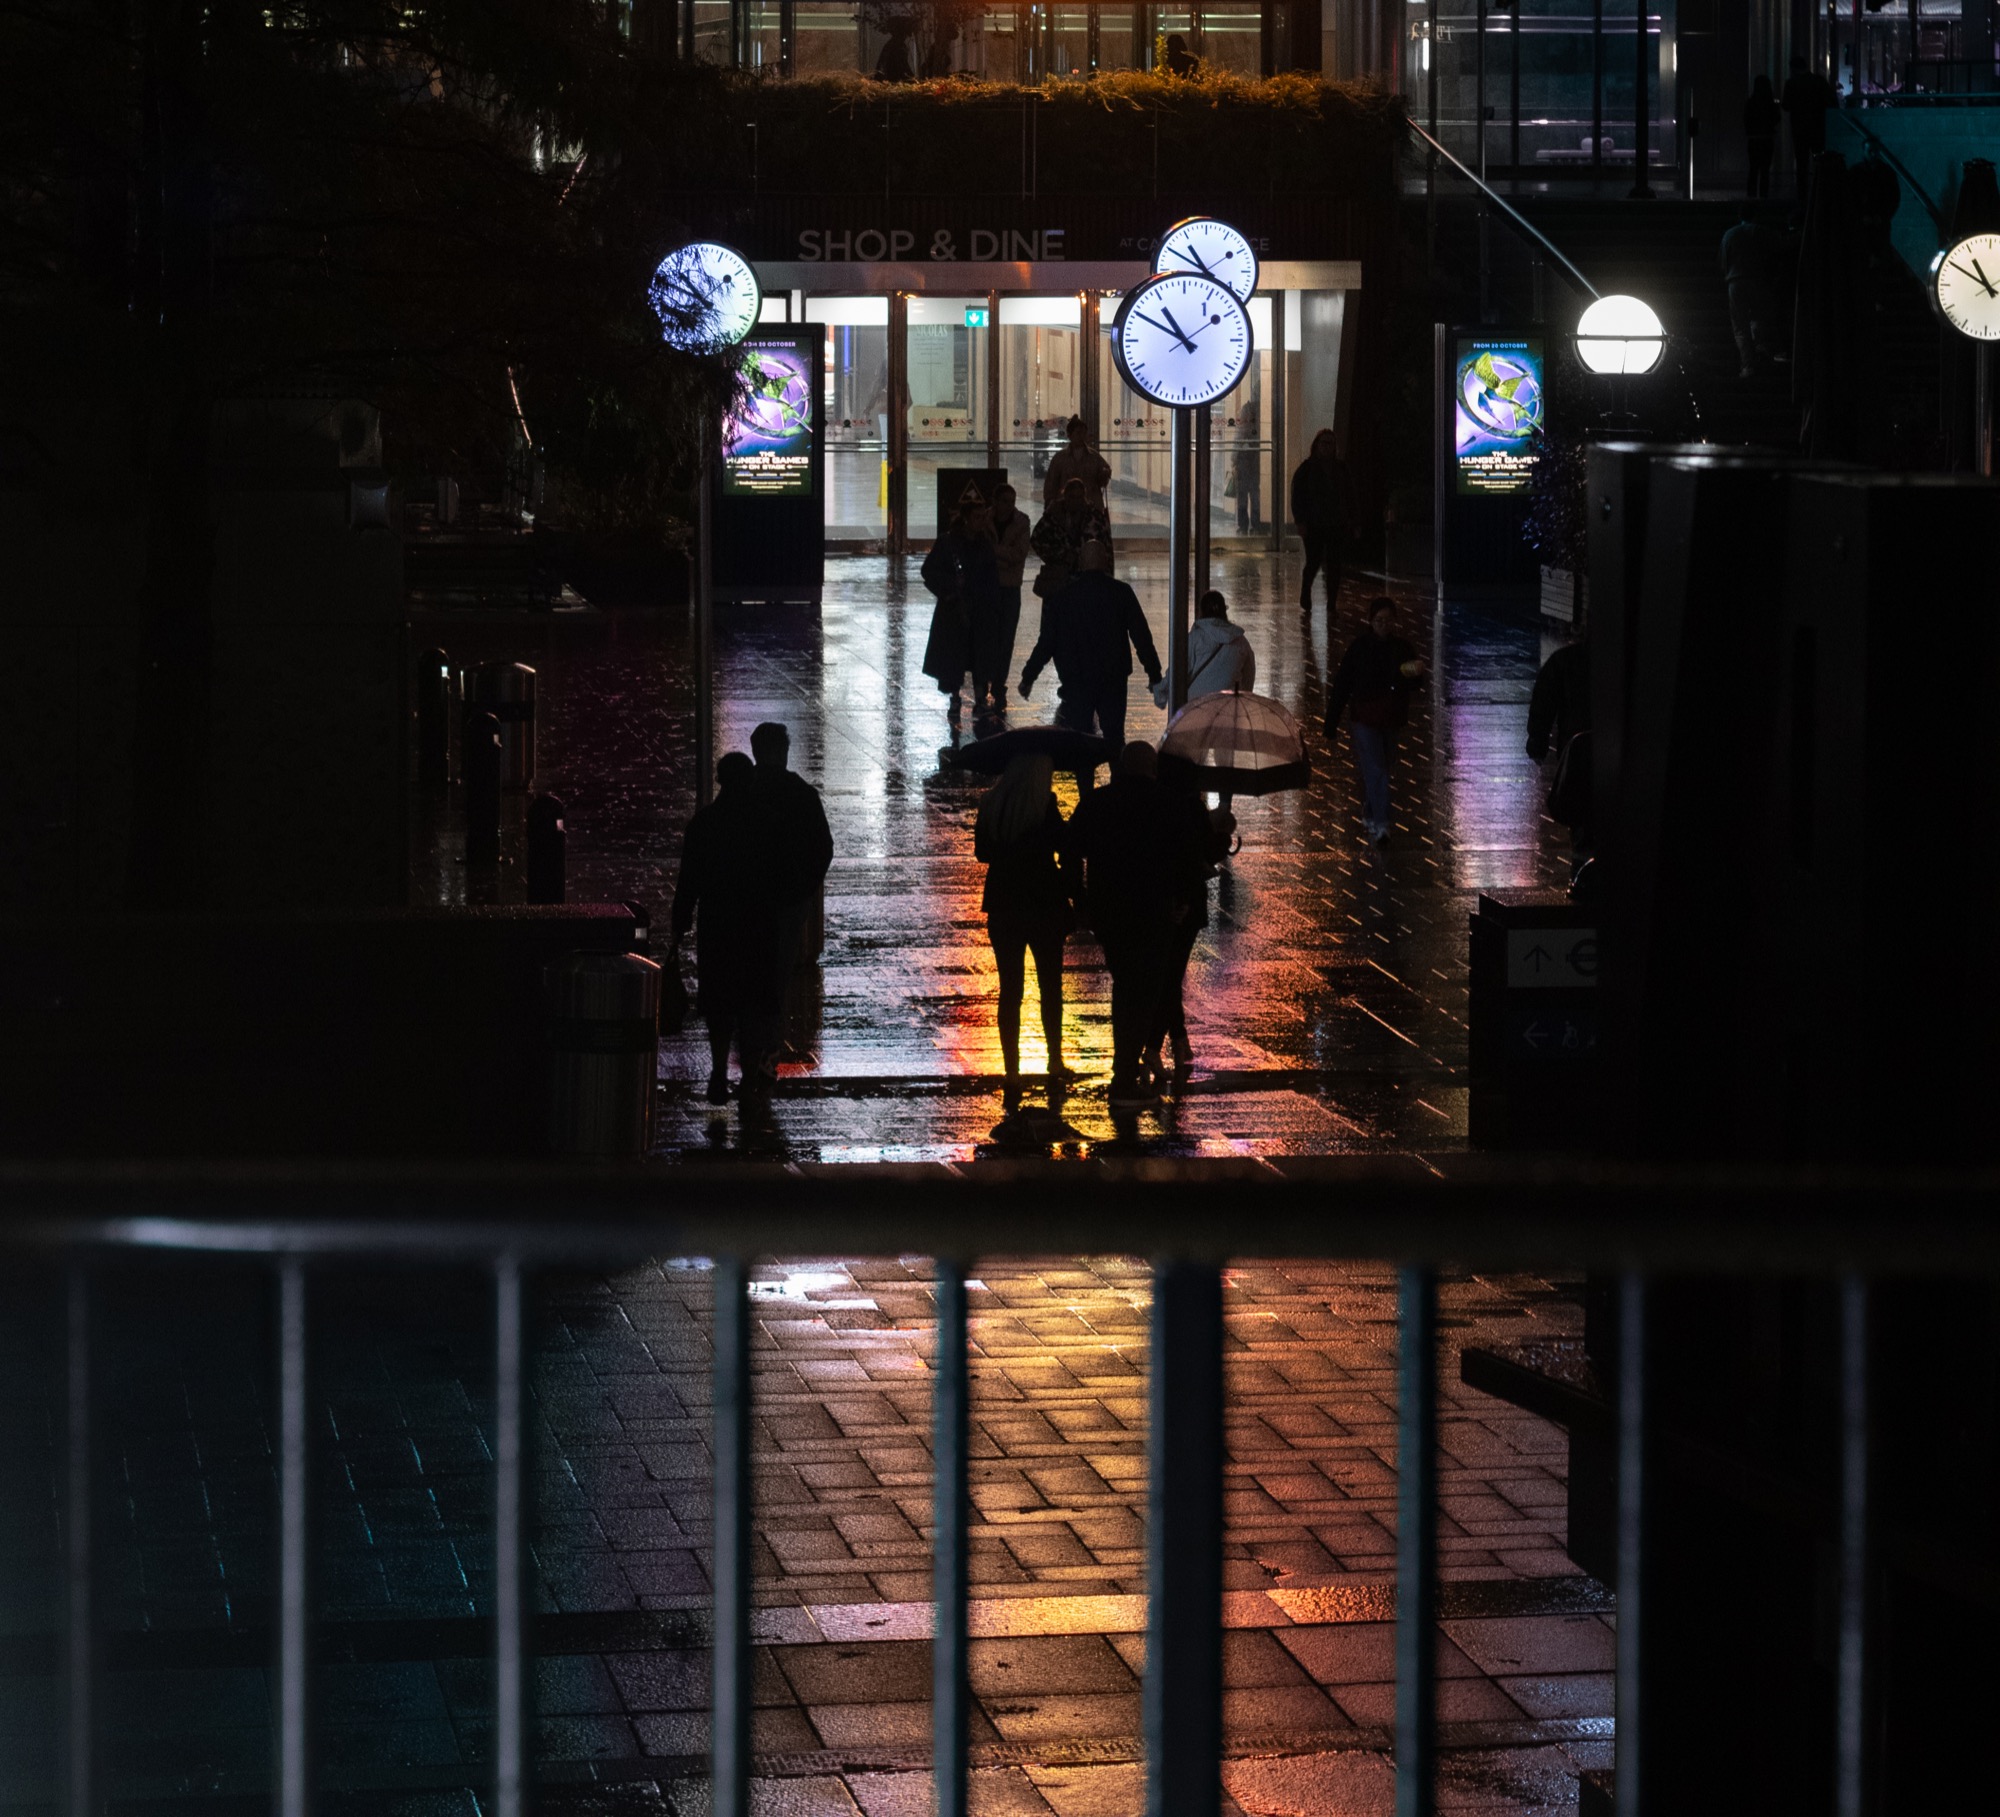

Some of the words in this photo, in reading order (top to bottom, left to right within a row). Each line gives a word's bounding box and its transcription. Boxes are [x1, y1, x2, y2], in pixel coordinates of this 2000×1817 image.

[798, 229, 915, 261] SHOP
[930, 229, 957, 261] &
[970, 230, 1065, 261] DINE
[1119, 238, 1132, 248] AT
[1201, 302, 1207, 317] 1
